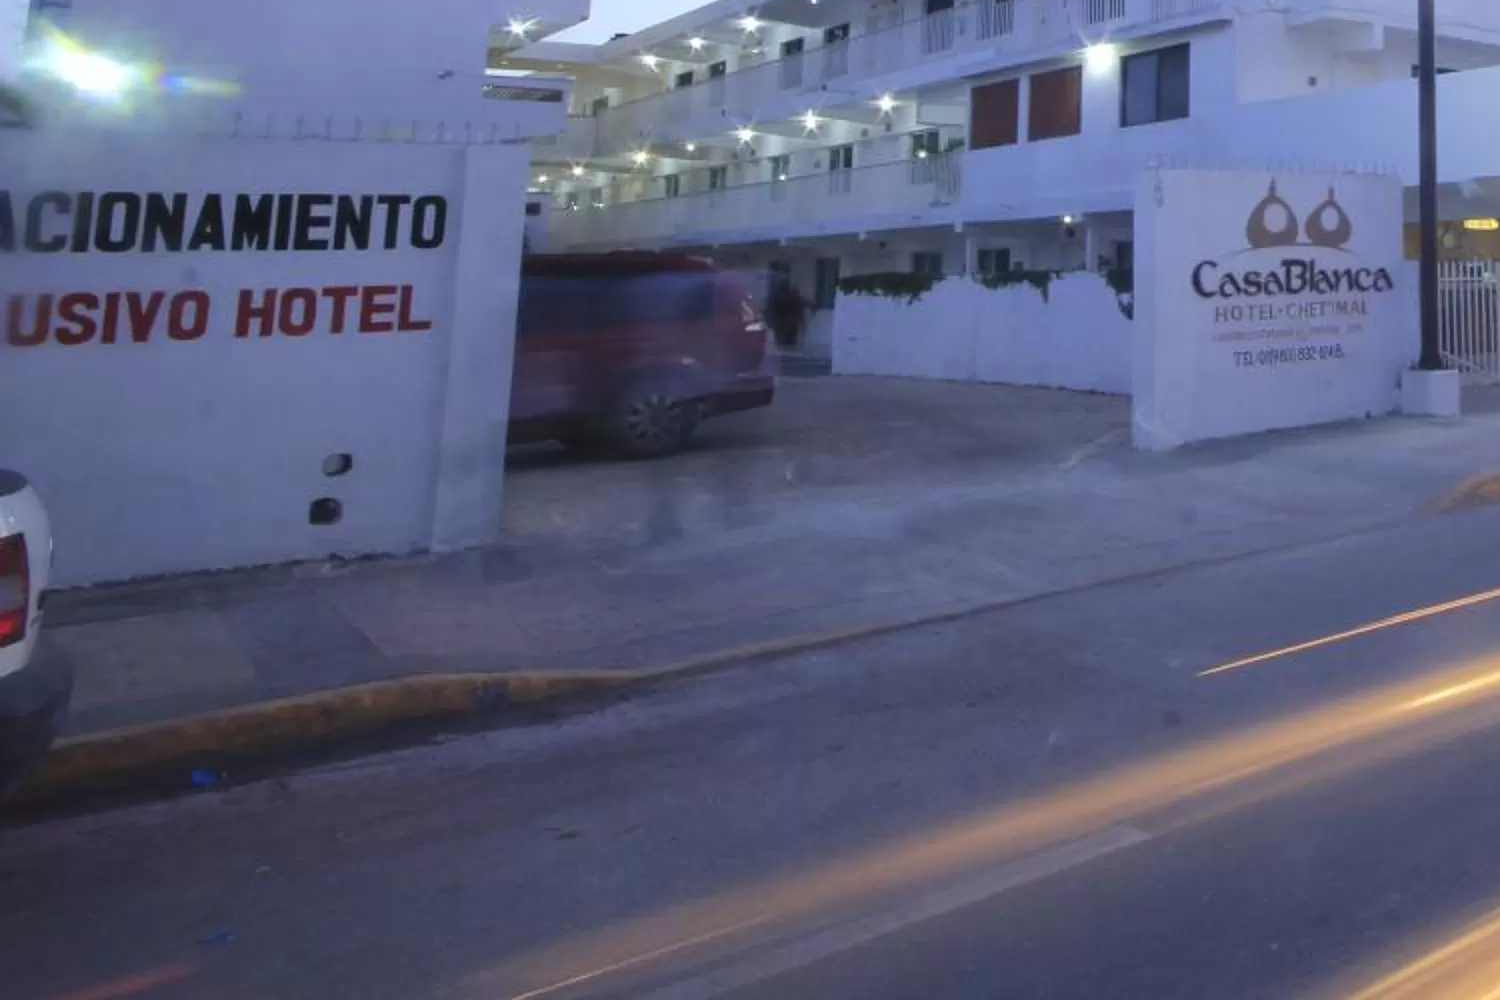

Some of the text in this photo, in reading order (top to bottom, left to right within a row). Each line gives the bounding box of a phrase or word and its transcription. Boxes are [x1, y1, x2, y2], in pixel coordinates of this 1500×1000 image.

[1192, 258, 1394, 298] CasaBlanca
[234, 285, 432, 338] HOTEL
[1215, 303, 1274, 322] HOTEL
